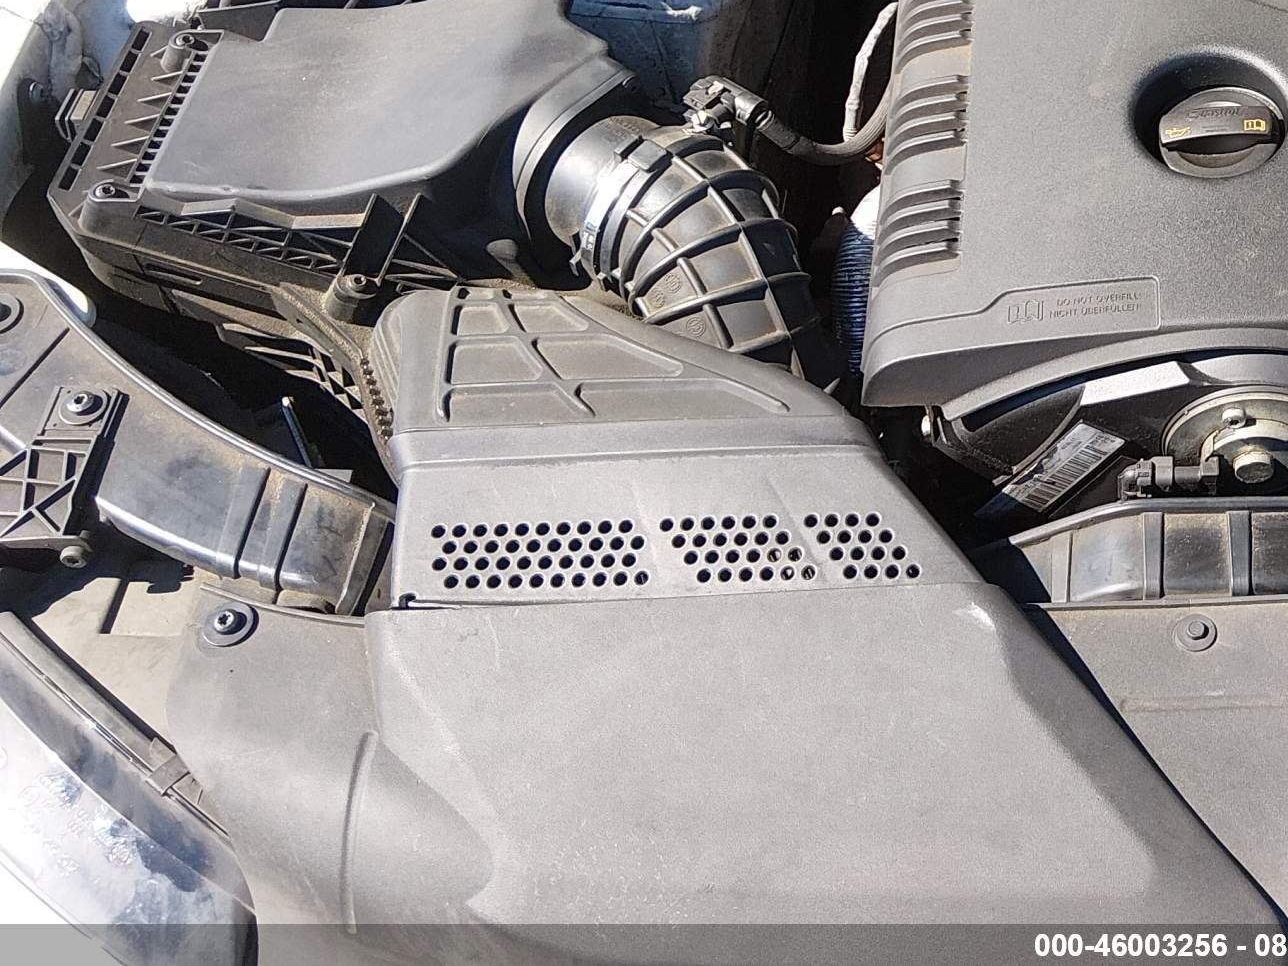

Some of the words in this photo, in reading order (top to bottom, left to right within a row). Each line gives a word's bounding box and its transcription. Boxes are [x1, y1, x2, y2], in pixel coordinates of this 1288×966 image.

[1057, 298, 1070, 306] DO
[1073, 296, 1093, 305] NOT
[1049, 309, 1078, 319] NICHT
